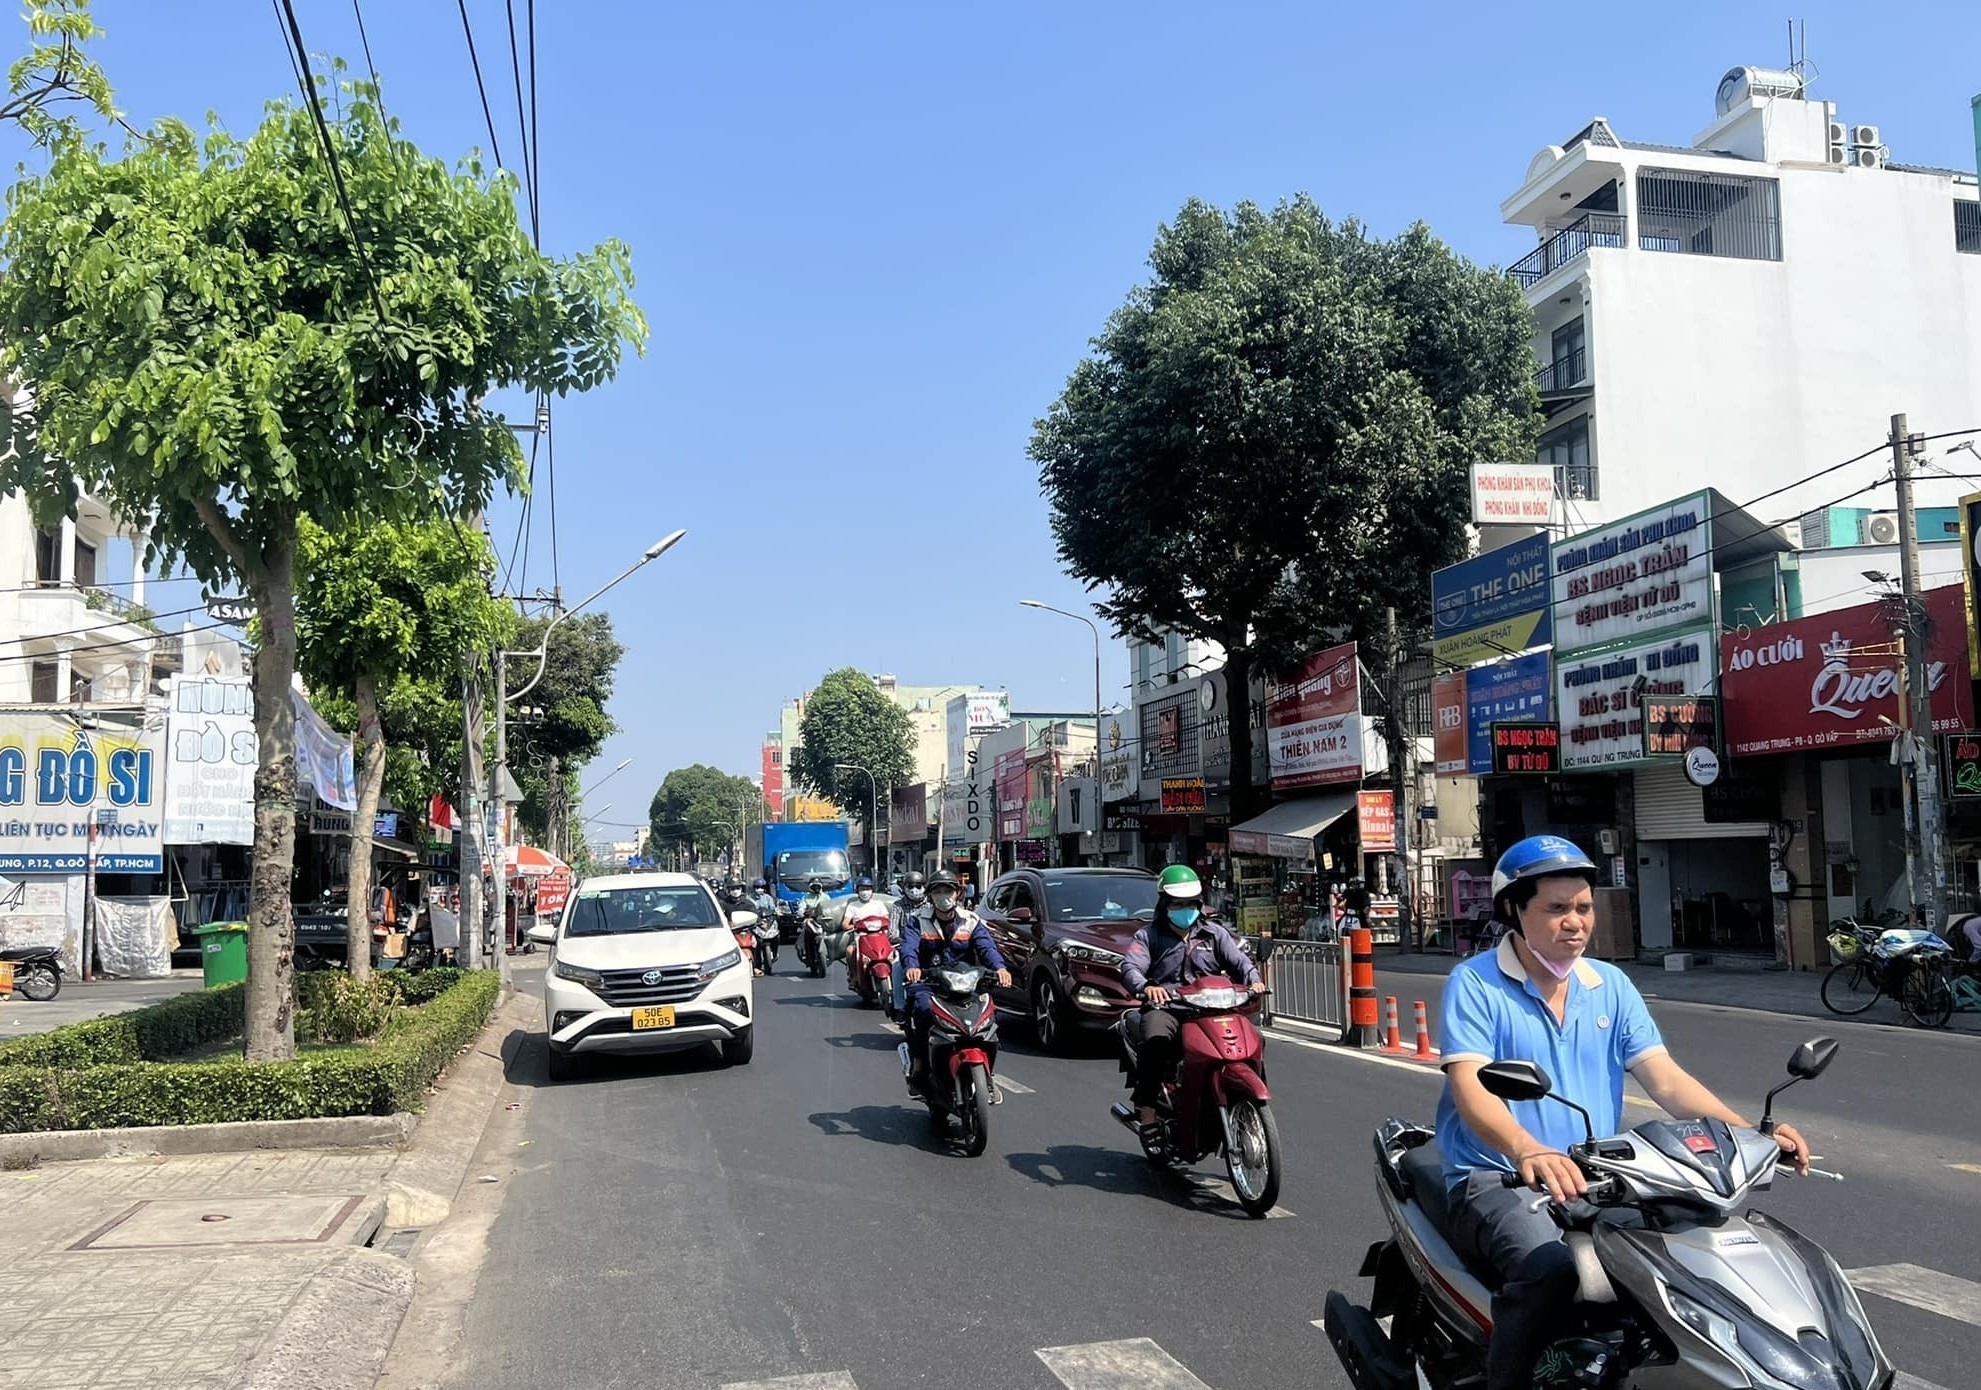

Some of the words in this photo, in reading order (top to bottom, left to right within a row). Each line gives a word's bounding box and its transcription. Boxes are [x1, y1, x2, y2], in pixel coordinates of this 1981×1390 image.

[1471, 577, 1504, 606] THE
[1508, 563, 1545, 594] ONE
[1728, 646, 1754, 672] ÁO
[1757, 634, 1804, 666] CƯỚI
[1579, 691, 1609, 717] BÁC
[1611, 686, 1628, 710] SĨ
[1649, 704, 1667, 723] BS
[1312, 737, 1337, 753] NAM
[1340, 735, 1348, 751] 2
[1497, 730, 1509, 747] BS
[1510, 730, 1533, 749] NGỌC
[1770, 738, 1791, 749] TRUNG
[1507, 754, 1520, 771] BV
[1591, 751, 1615, 764] QUNG
[1617, 749, 1641, 762] TRUNG
[1692, 758, 1718, 772] Queen
[36, 729, 98, 806] ĐỒ
[107, 748, 153, 806] SI
[967, 751, 980, 831] SIXDO
[36, 823, 67, 841] TỤC
[108, 819, 157, 838] NGÀY
[115, 858, 154, 870] TP.HCM
[645, 1007, 663, 1018] 50E
